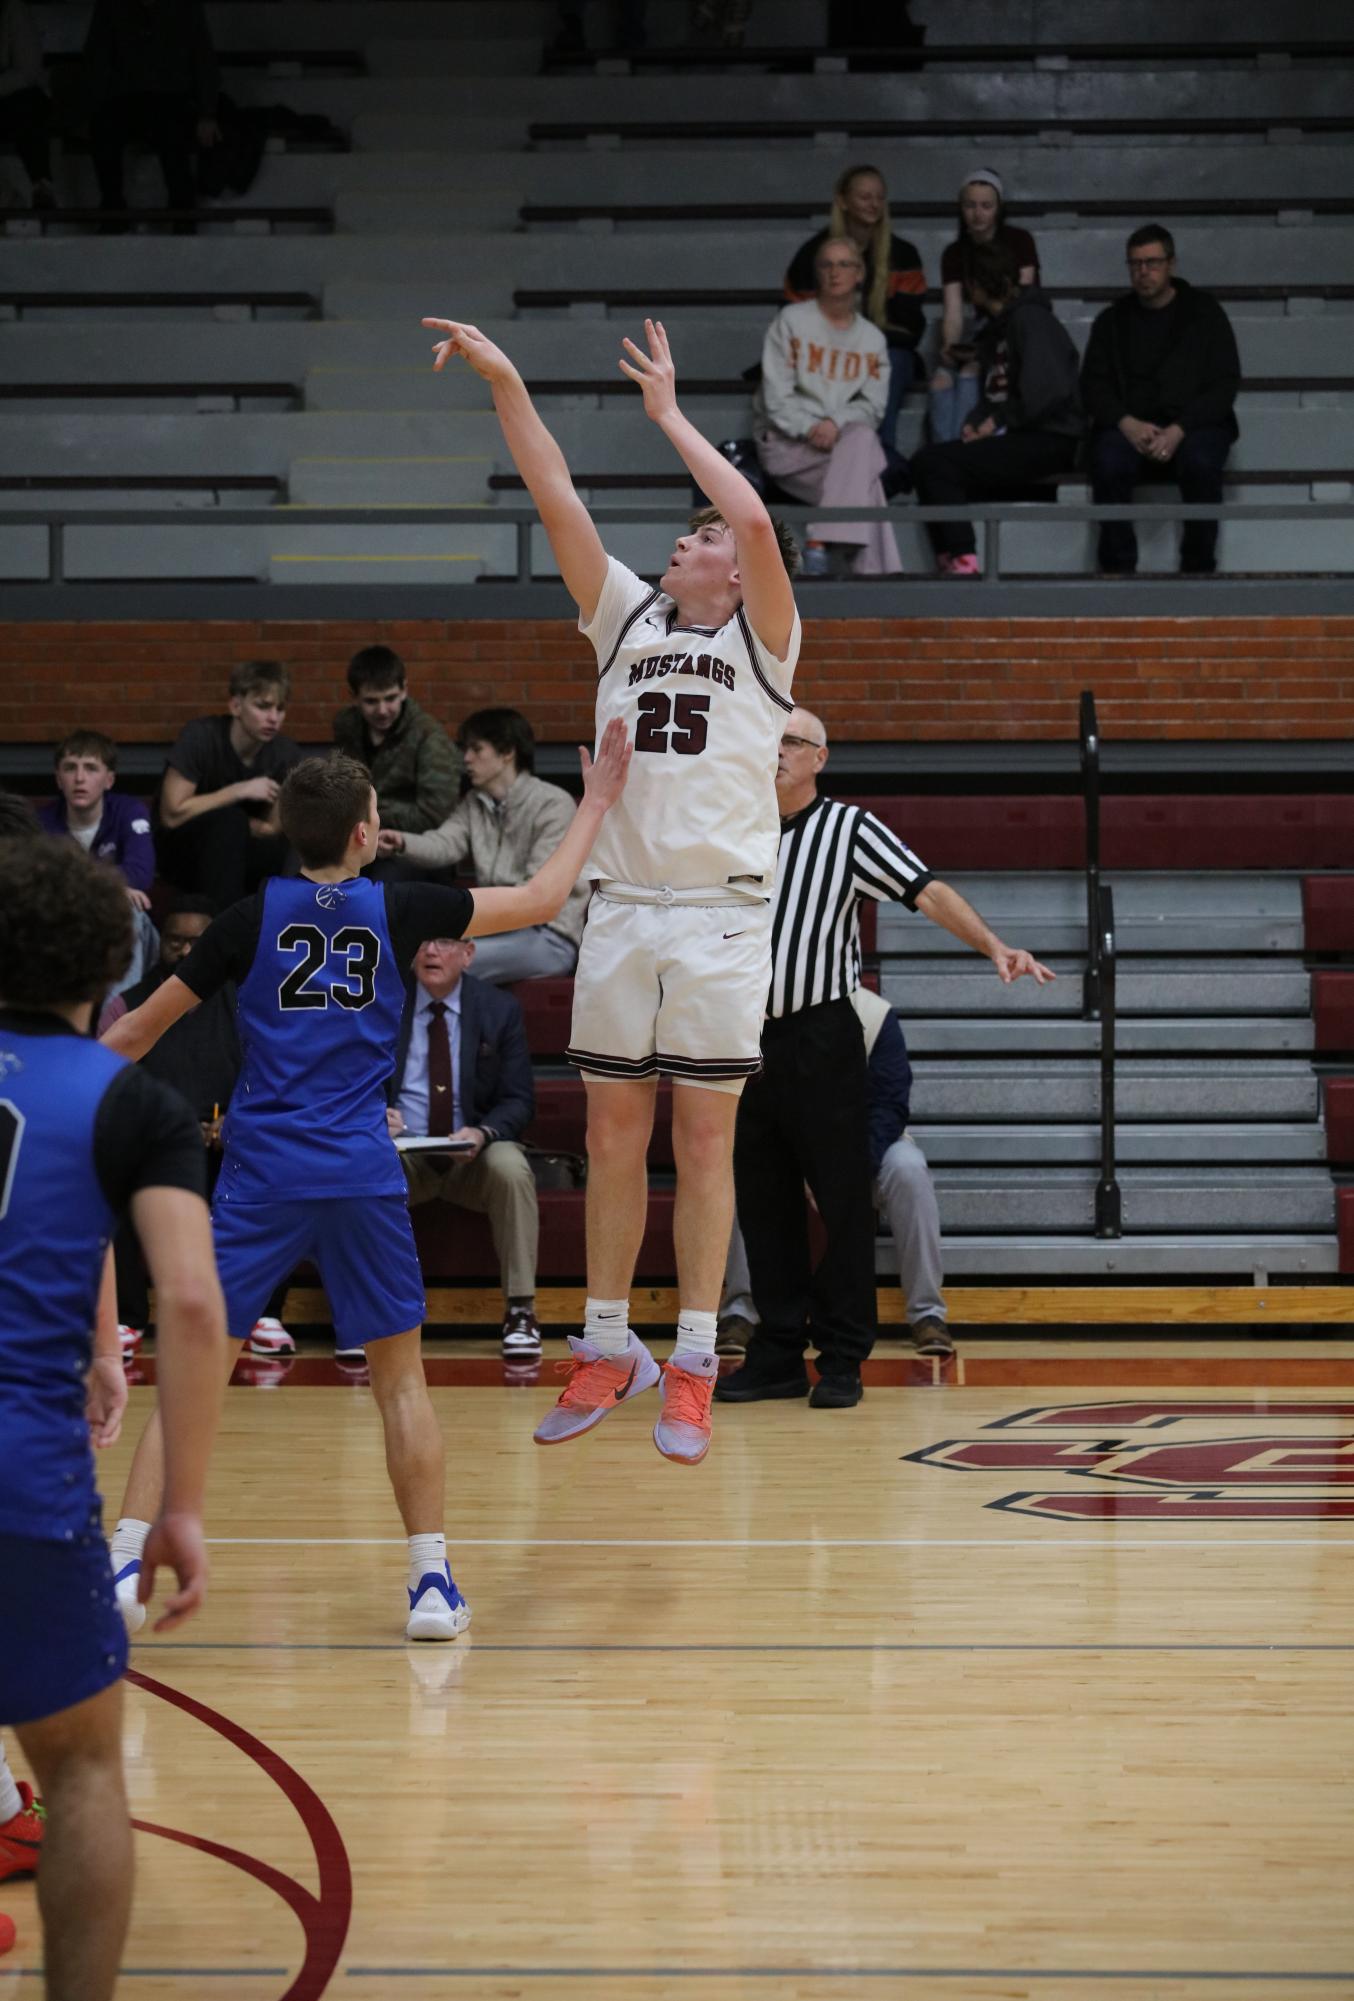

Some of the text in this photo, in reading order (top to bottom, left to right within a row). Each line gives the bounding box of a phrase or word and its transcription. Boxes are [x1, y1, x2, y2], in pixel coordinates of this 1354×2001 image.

[628, 653, 735, 691] MUSTANGS
[635, 692, 711, 755] 25
[277, 923, 381, 1011] 23
